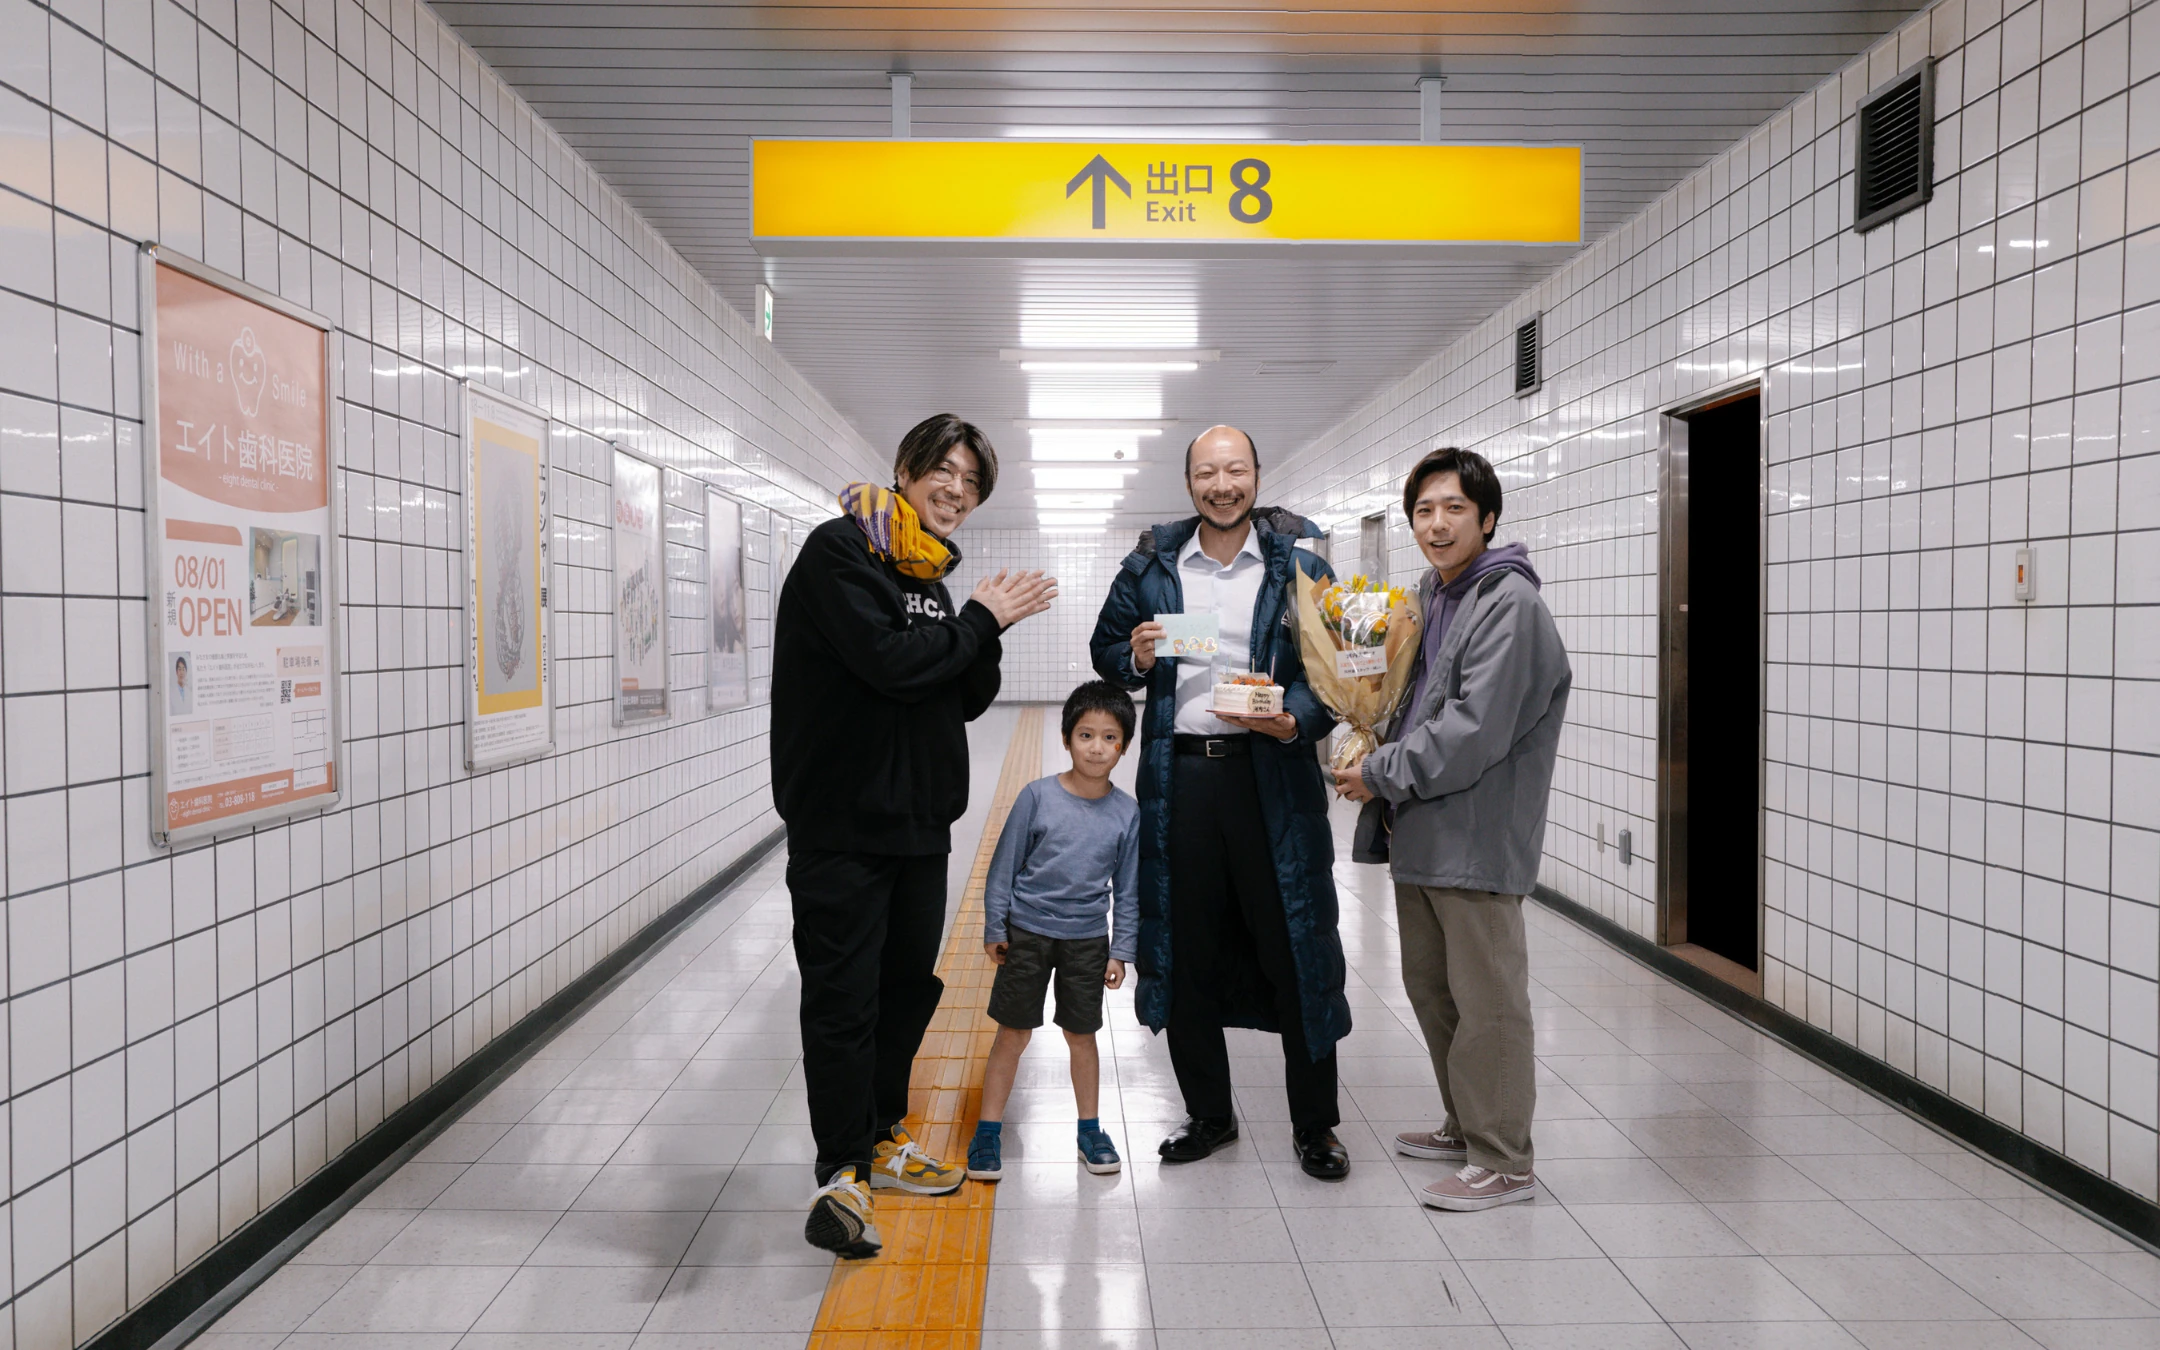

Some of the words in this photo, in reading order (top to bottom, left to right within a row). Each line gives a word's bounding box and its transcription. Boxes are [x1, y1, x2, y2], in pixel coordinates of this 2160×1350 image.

[1146, 161, 1213, 196] 出口
[1228, 158, 1273, 224] 8
[1146, 200, 1196, 222] Exit
[174, 341, 209, 379] With
[216, 362, 224, 383] a
[272, 374, 306, 408] Smile
[175, 419, 313, 482] エイト歯科医院
[174, 554, 226, 590] 08/01
[178, 596, 243, 637] OPEN
[1254, 691, 1270, 700] Happy
